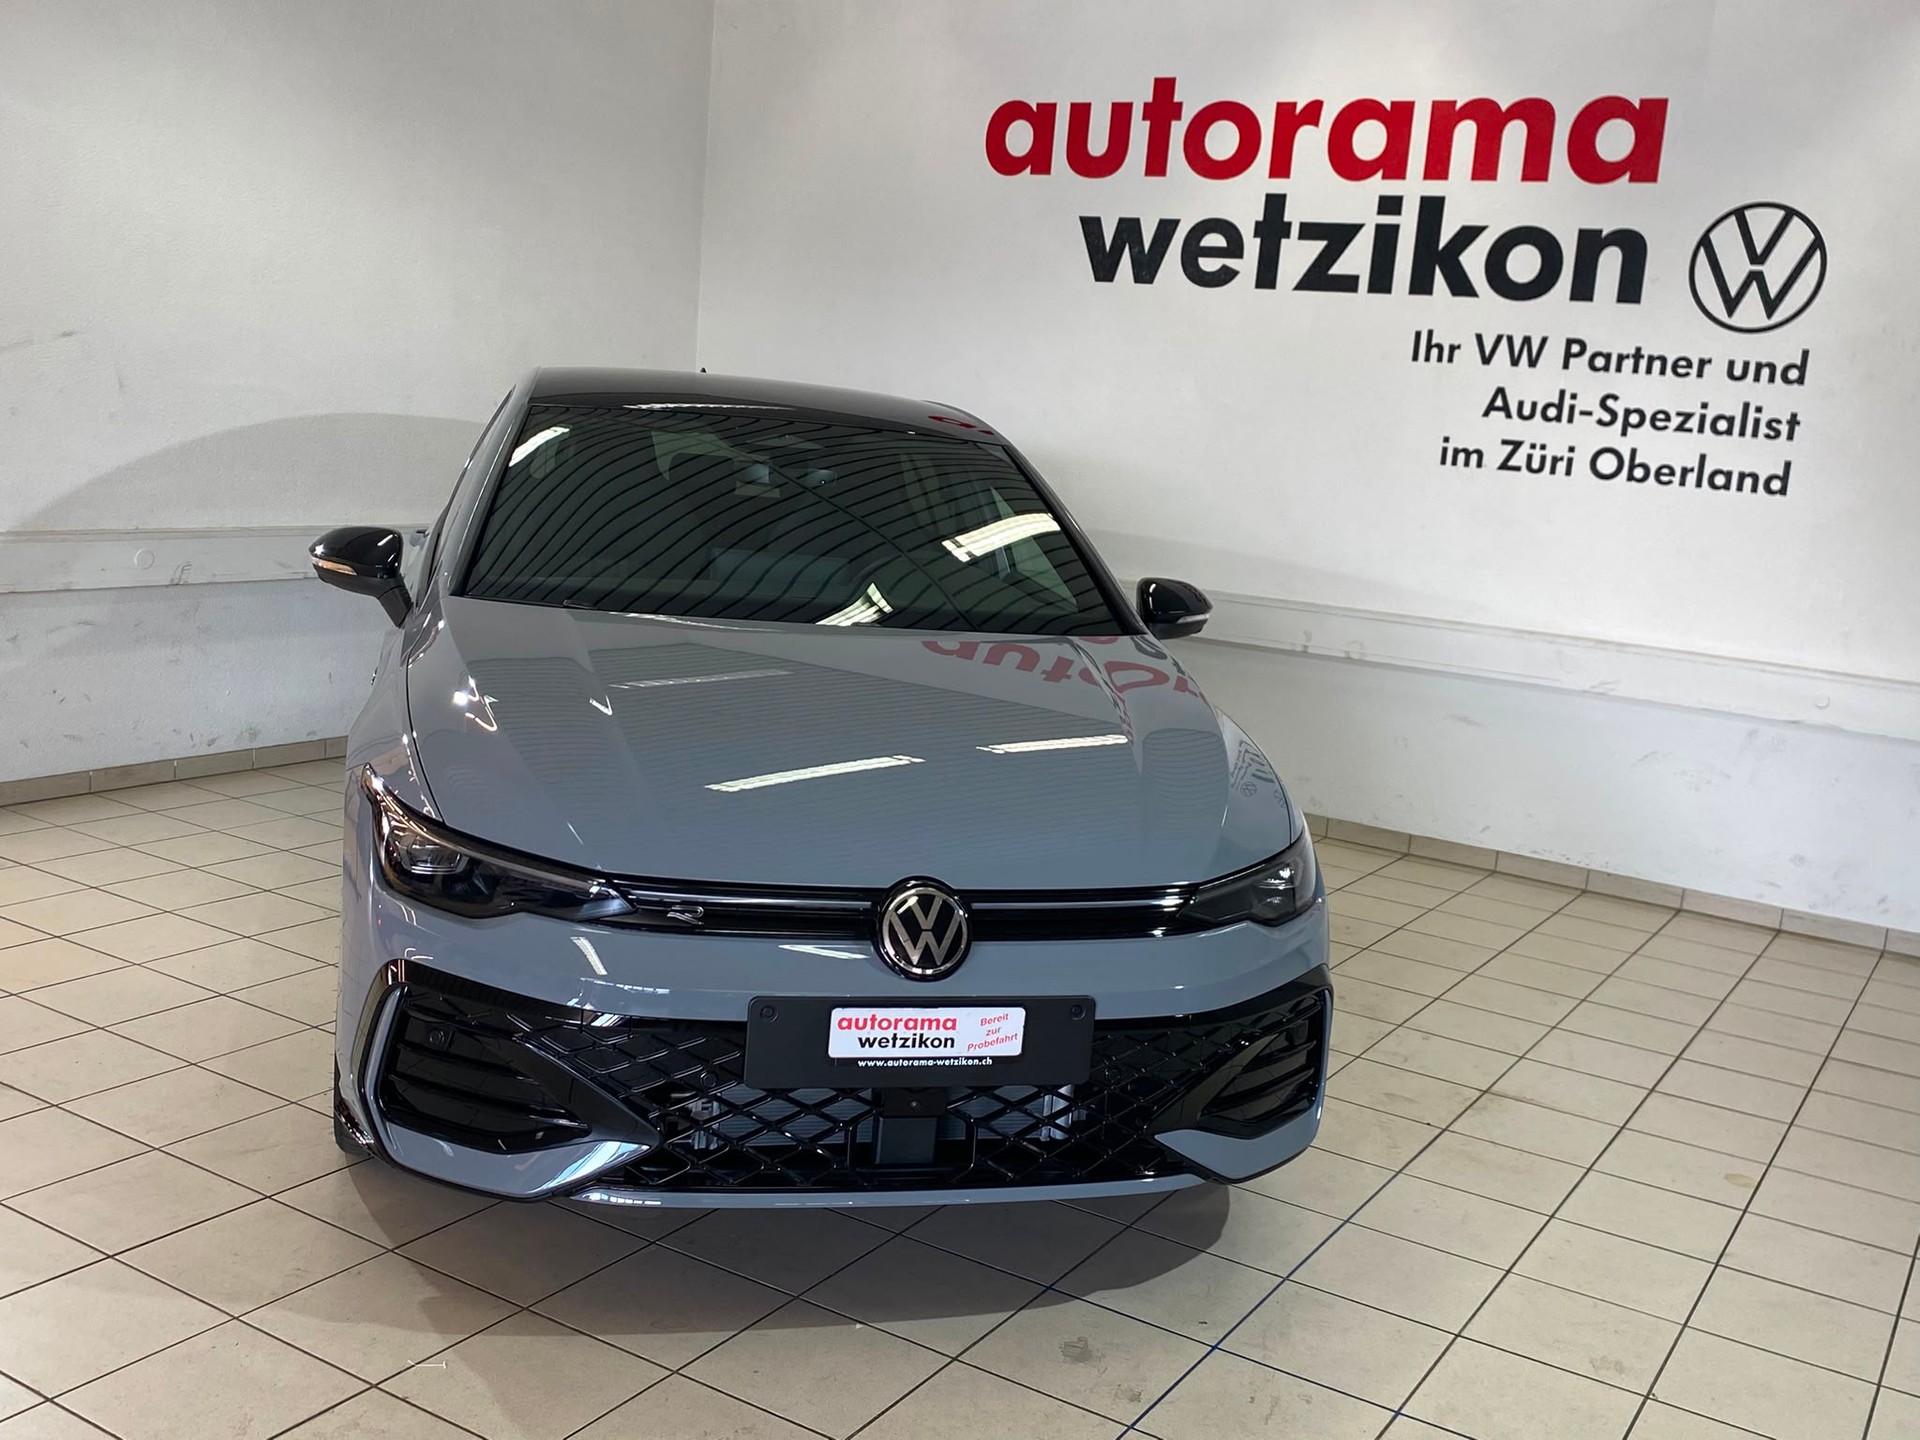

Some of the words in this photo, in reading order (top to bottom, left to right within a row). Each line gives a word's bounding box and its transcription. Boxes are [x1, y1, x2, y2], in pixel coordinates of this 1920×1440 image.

[985, 77, 1668, 184] autorama
[1079, 194, 1647, 304] wetzikon
[1412, 330, 1461, 363] Ihr
[1476, 334, 1548, 367] VW
[1563, 338, 1712, 378] Partner
[1727, 350, 1809, 386] und
[1483, 387, 1801, 441] Audi-Spezialist
[1441, 437, 1484, 469] im
[1498, 439, 1576, 477] Züri
[1590, 447, 1791, 496] Oberland
[837, 1014, 958, 1032] autorama
[980, 1013, 1009, 1027] Bereit
[857, 1032, 956, 1049] wetzikon
[985, 1026, 1002, 1037] zur
[967, 1033, 1018, 1052] Probefahrt
[857, 1057, 993, 1068] www.autorama-wetzikon.ch
